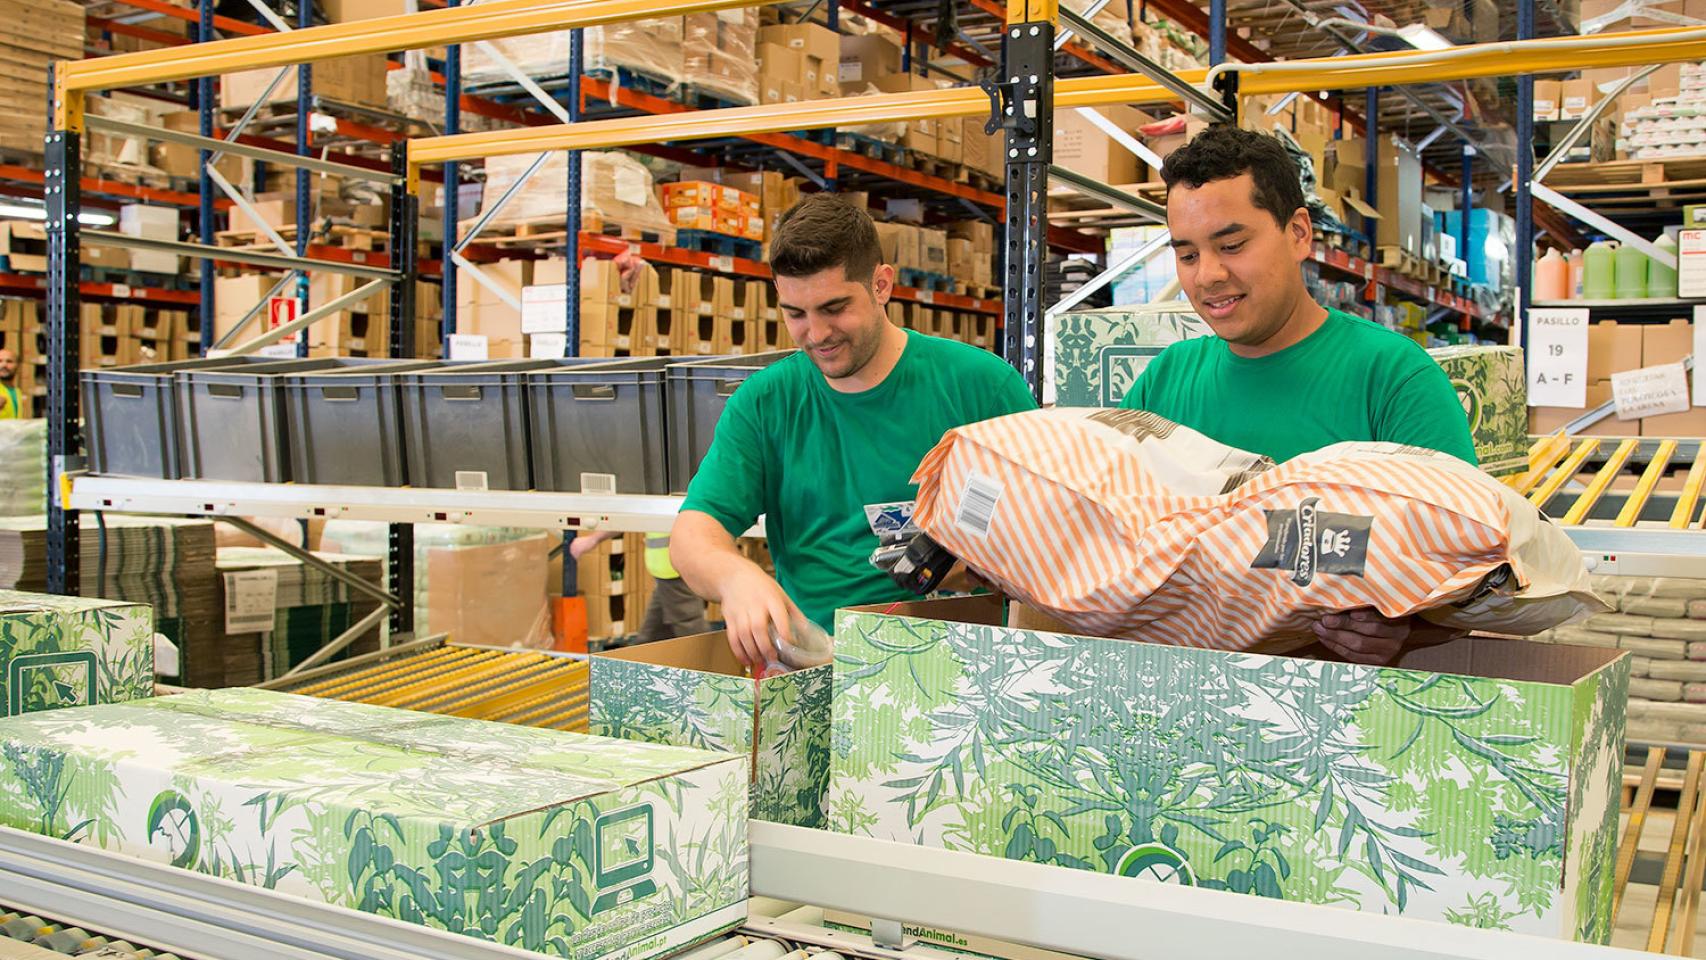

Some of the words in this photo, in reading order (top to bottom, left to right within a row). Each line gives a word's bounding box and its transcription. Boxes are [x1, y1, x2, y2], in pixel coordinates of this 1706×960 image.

[1536, 317, 1580, 326] PASILLO
[1548, 344, 1563, 356] 19
[1537, 372, 1547, 384] A
[1564, 373, 1573, 385] F
[1300, 505, 1315, 580] Criadores
